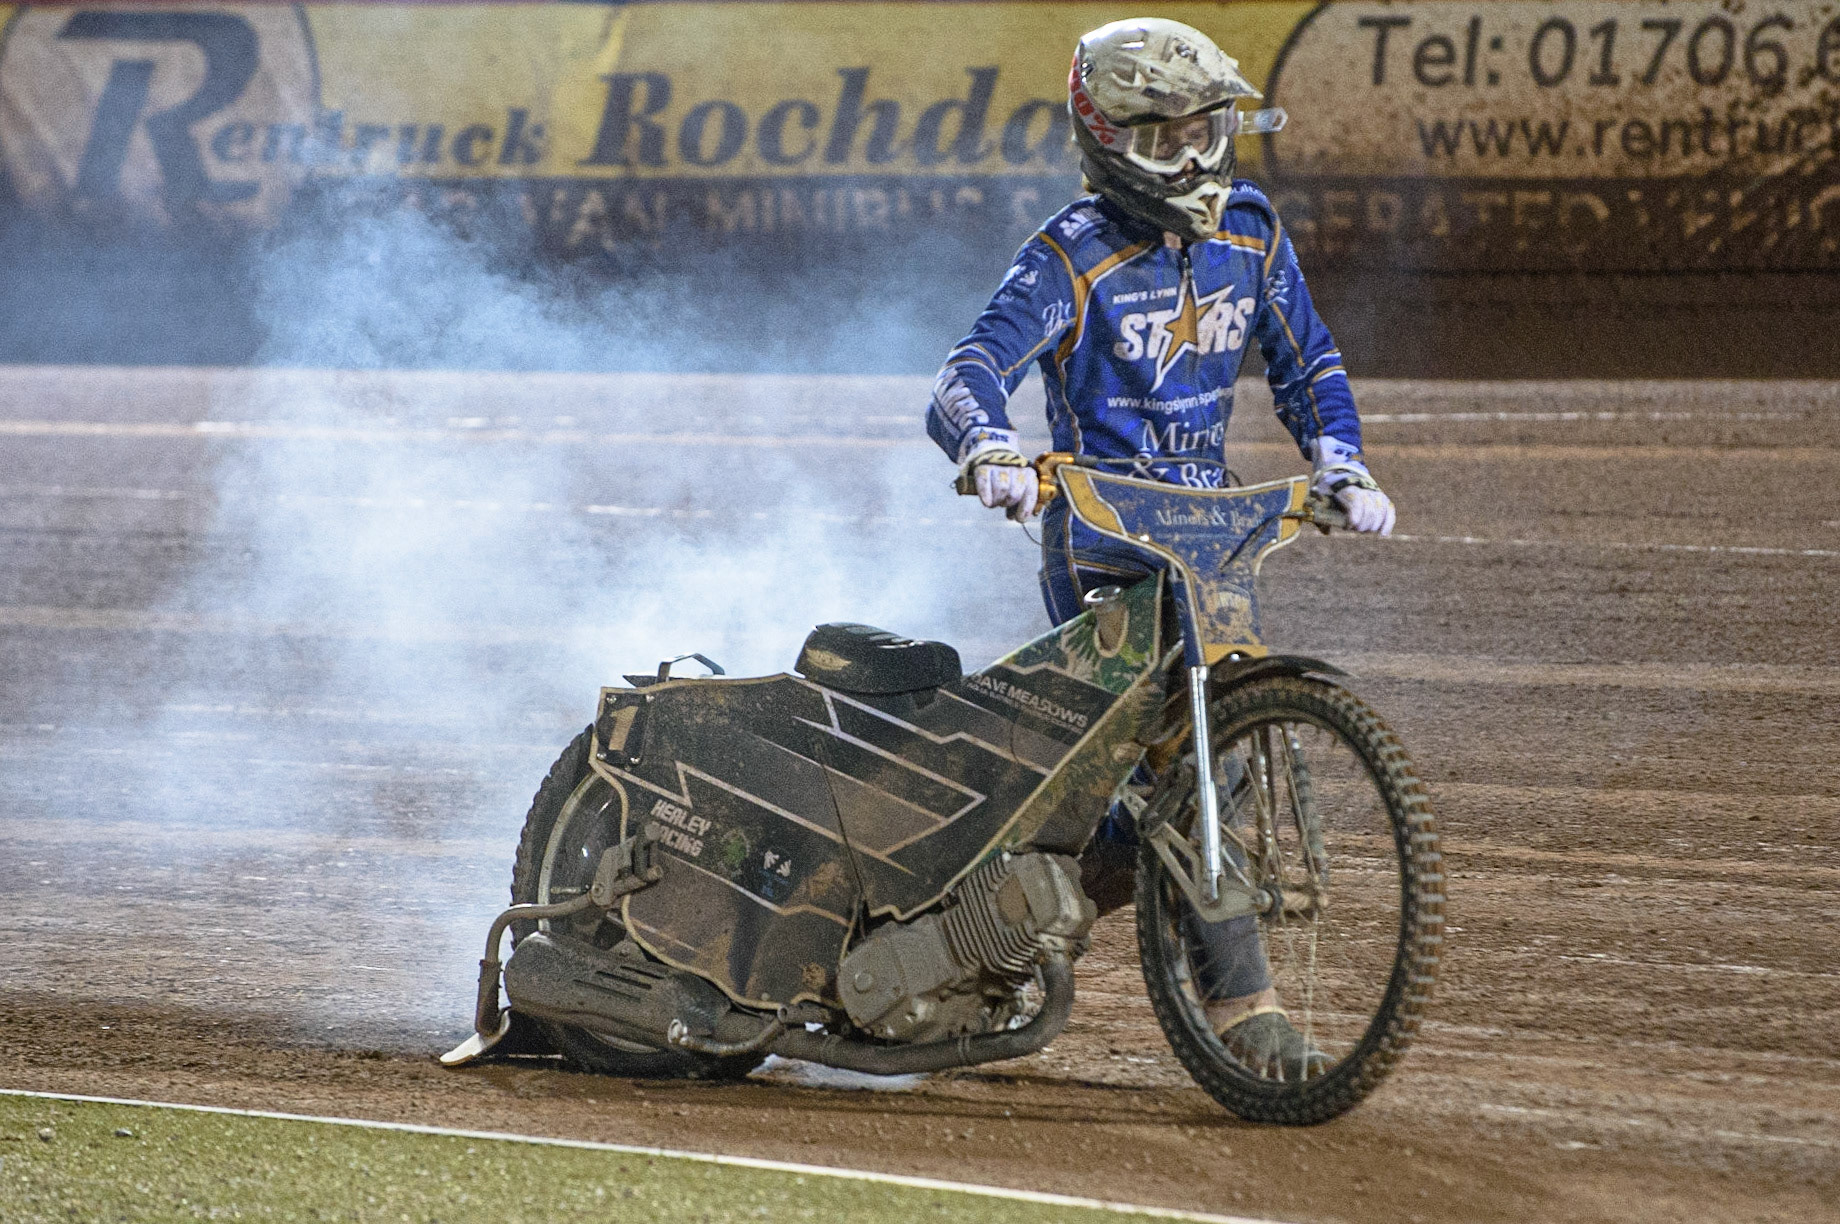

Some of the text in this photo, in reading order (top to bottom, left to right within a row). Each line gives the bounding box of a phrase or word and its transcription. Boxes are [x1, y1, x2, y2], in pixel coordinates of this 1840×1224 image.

[1358, 17, 1503, 87] Tel:
[1529, 14, 1795, 88] 01706
[1113, 286, 1177, 305] KING'S LYNN
[1128, 452, 1170, 481] &
[1211, 505, 1226, 526] &
[1006, 685, 1088, 728] MEADOWS
[610, 705, 639, 751] 1
[650, 799, 712, 836] HEALEY
